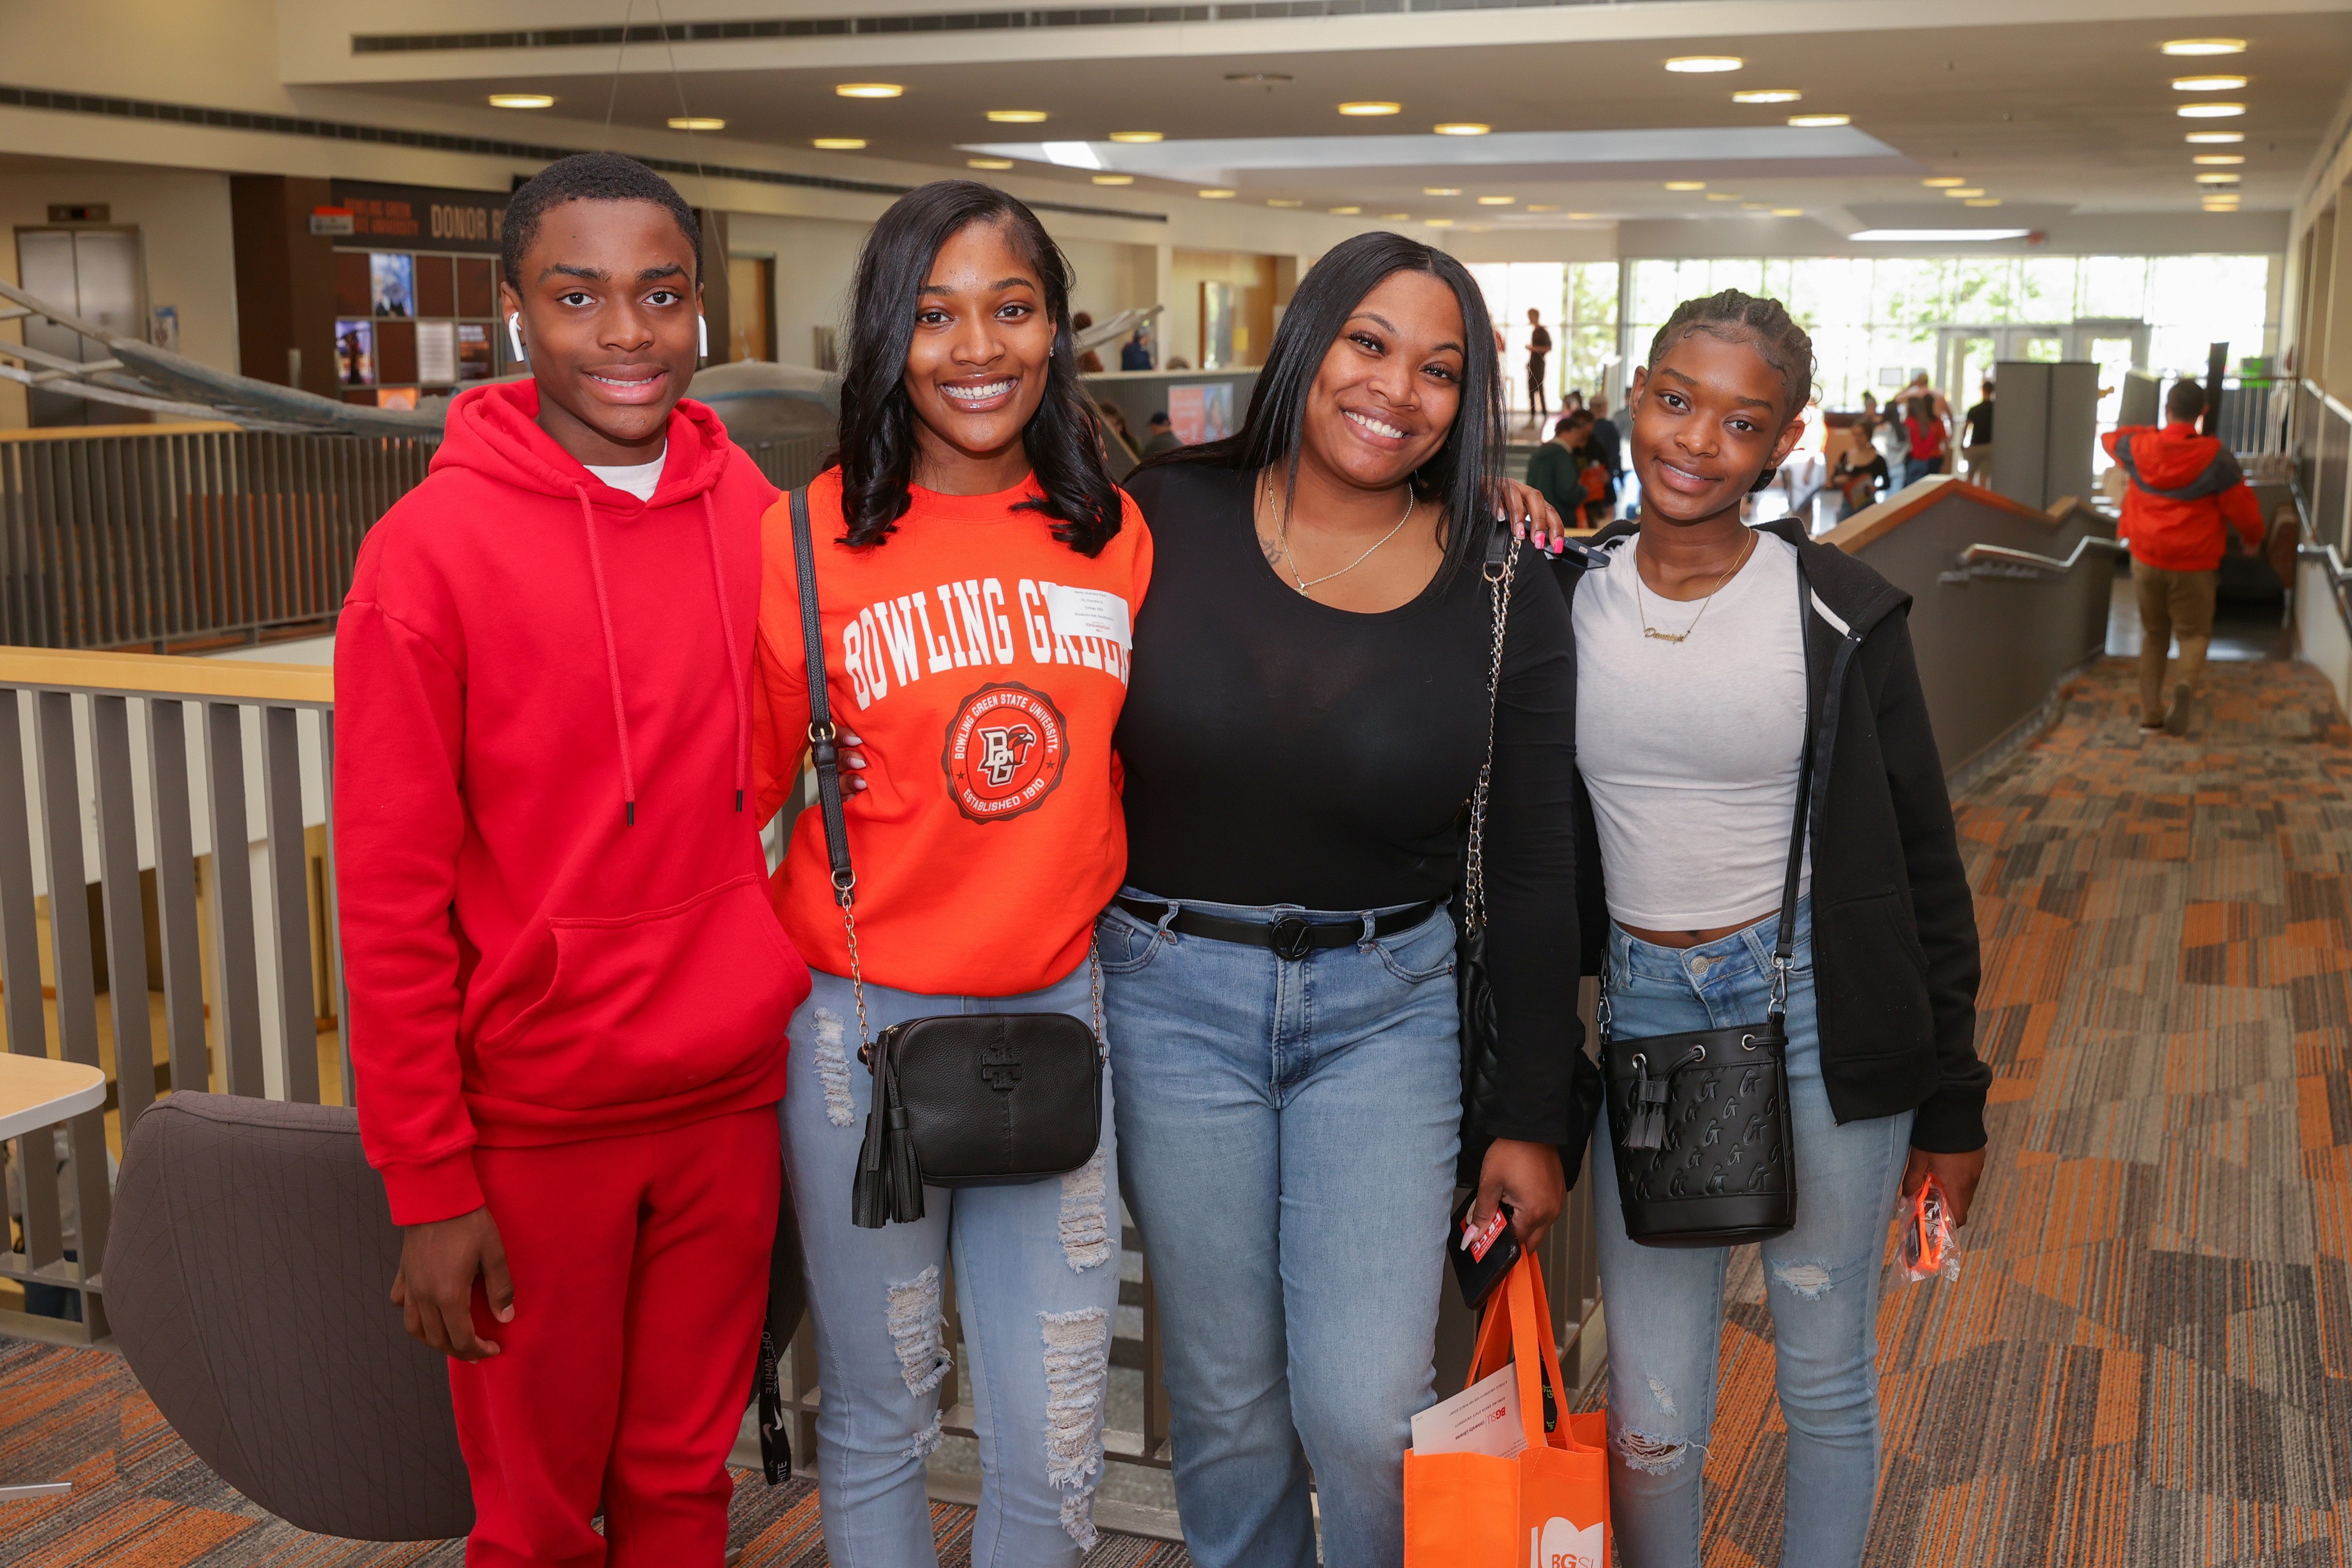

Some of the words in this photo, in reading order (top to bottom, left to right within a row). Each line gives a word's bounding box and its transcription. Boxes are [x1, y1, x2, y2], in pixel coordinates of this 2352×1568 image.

[430, 204, 488, 240] DONOR
[843, 578, 1014, 711] BOWLING
[954, 715, 974, 760] BOWLING
[971, 695, 998, 717] GREEN
[1000, 693, 1029, 709] STATE
[963, 788, 1021, 812] ESTABLISHED
[1022, 777, 1045, 800] 1910
[761, 1332, 775, 1395] OFF-WHITE
[1455, 1415, 1472, 1428] UNIVERSITY
[1455, 1430, 1469, 1440] Libraries
[1469, 1420, 1485, 1432] University
